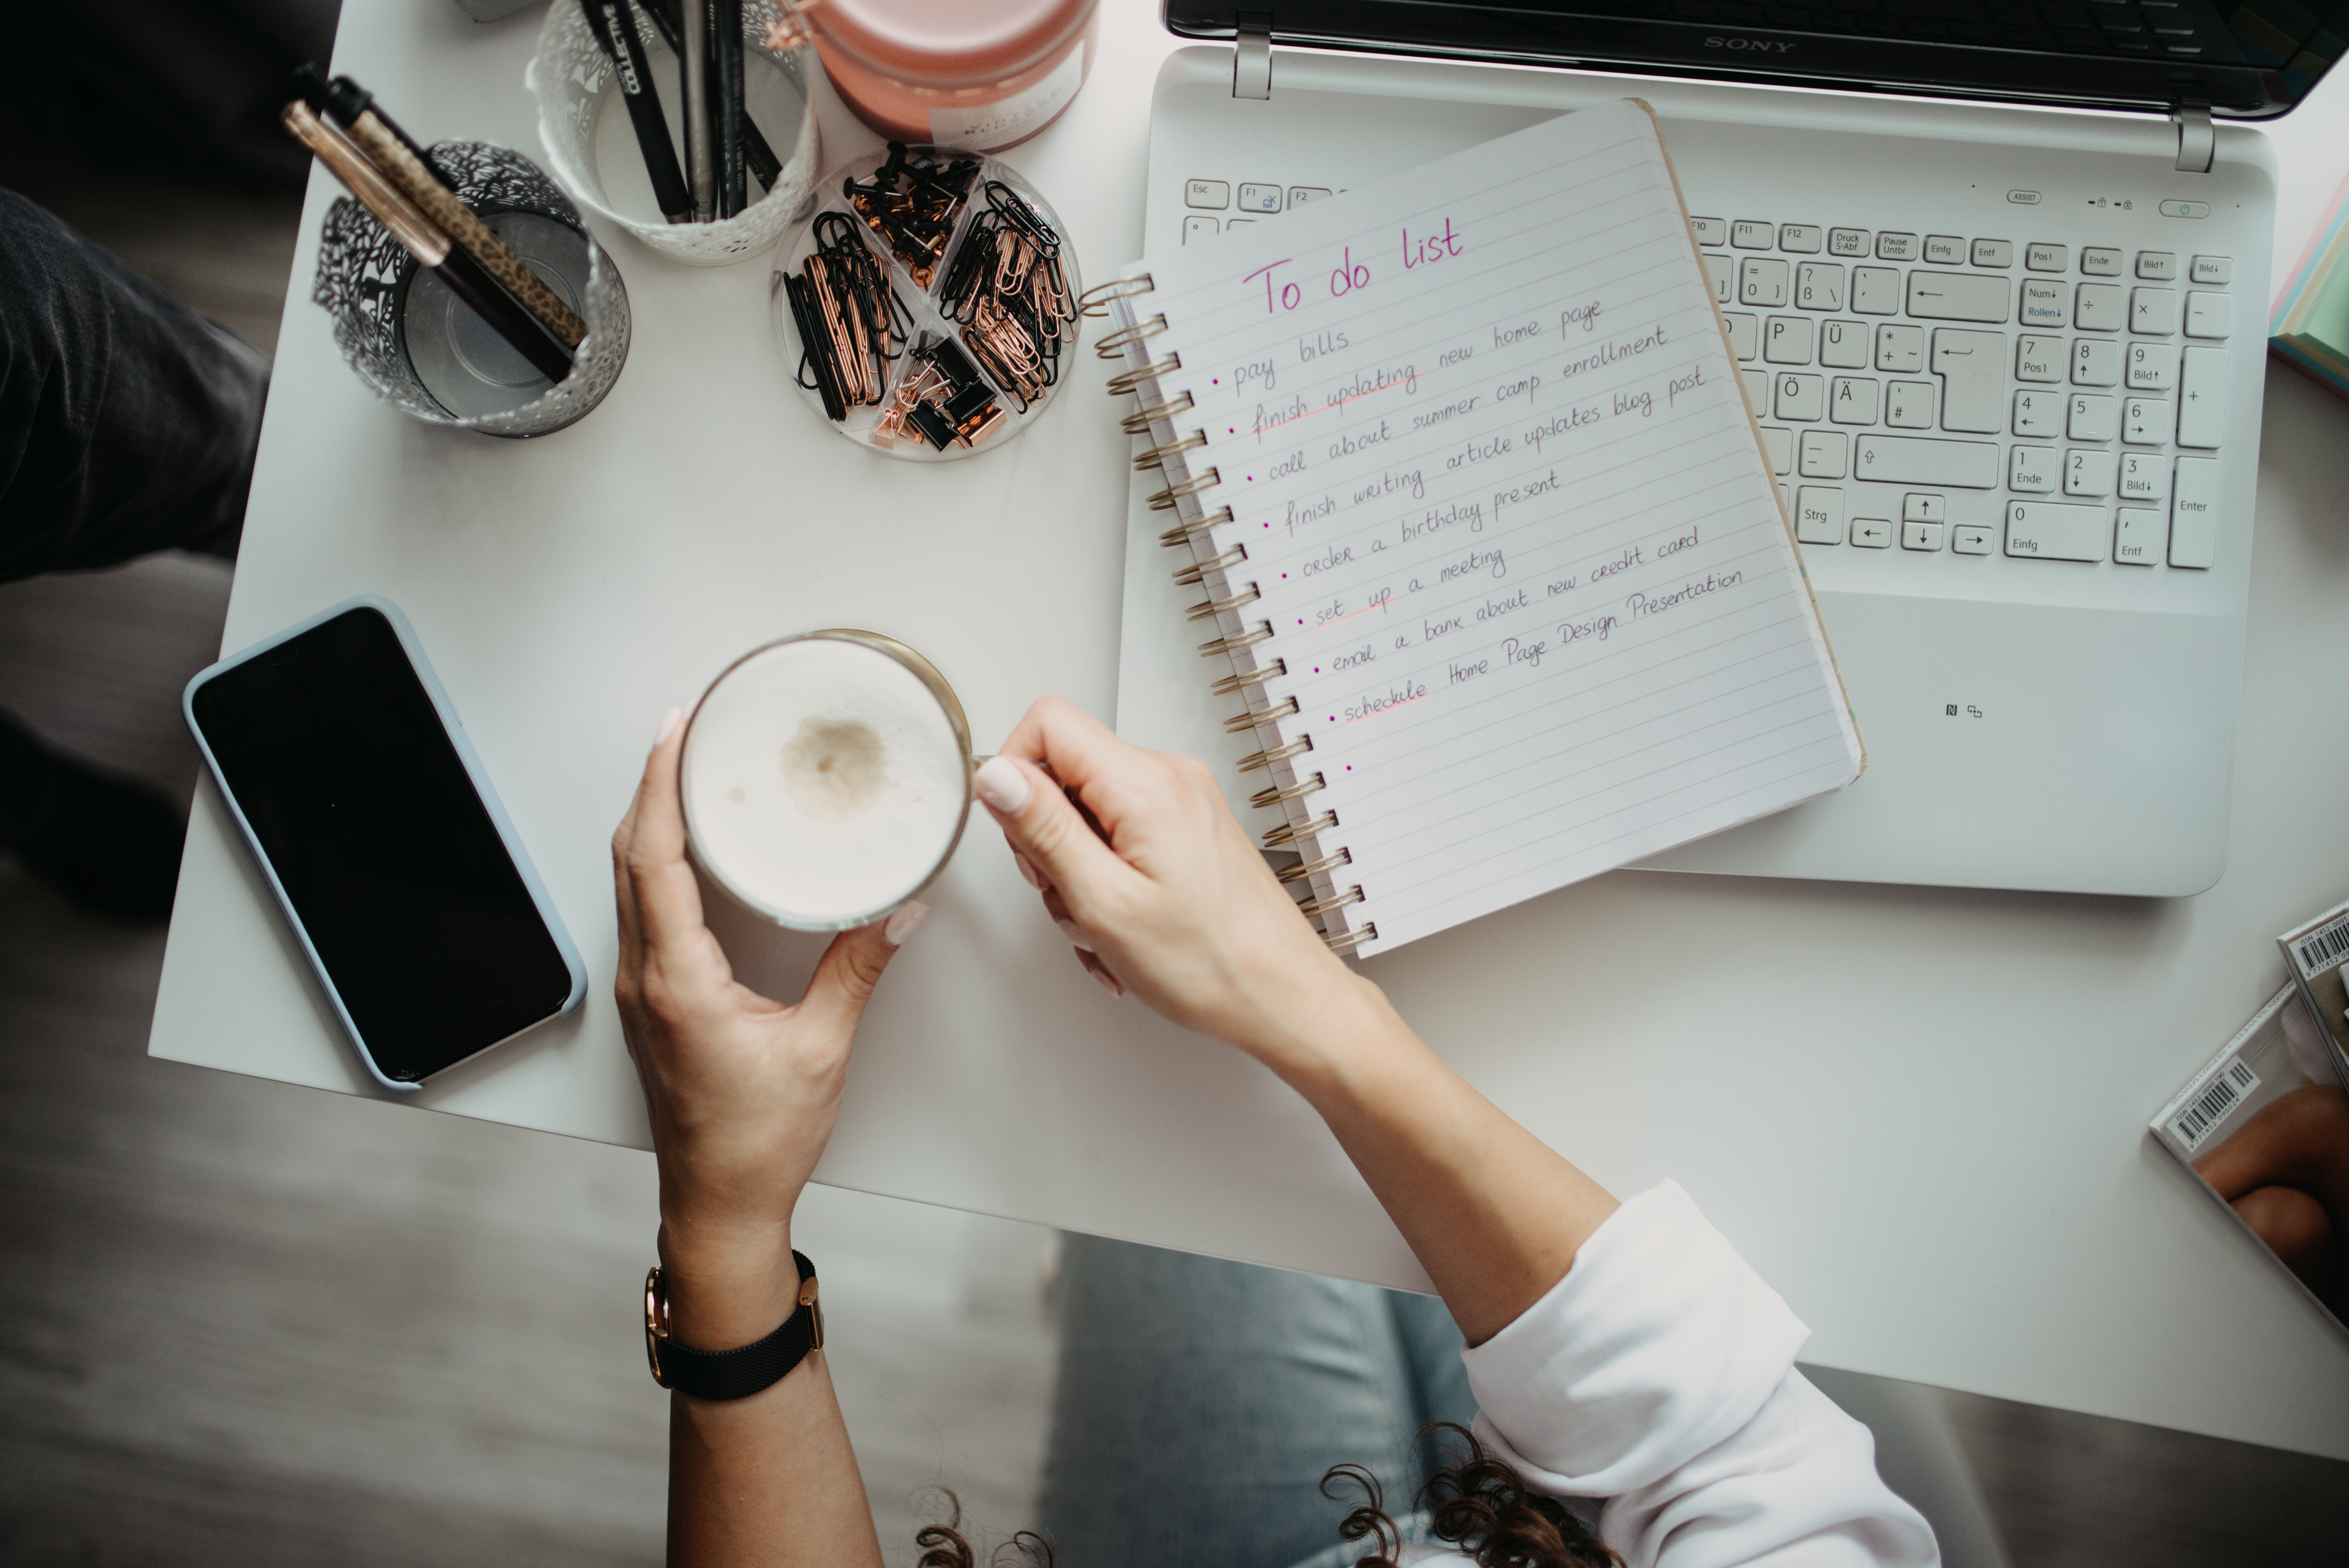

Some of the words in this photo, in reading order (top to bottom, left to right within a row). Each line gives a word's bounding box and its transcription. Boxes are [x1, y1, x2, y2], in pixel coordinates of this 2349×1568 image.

[602, 3, 642, 95] COLLECTIVE
[1703, 36, 1797, 53] SONY
[1193, 184, 1208, 193] Esc
[1246, 188, 1256, 197] F1
[1296, 192, 1307, 201] F2
[1691, 221, 1706, 230] F10
[1739, 225, 1752, 234] F11
[1788, 228, 1802, 238] F12
[1836, 233, 1859, 242] Druck
[1836, 242, 1857, 251] S-Abf
[1884, 238, 1907, 246] Pause
[1884, 246, 1905, 254] Untbr
[1931, 244, 1951, 256] Einfg
[1979, 248, 1995, 257] Entf
[2034, 252, 2052, 261] Pos1
[2089, 256, 2109, 265] Ende
[1243, 259, 1300, 313] To
[1331, 247, 1369, 296] do
[1805, 268, 1813, 282] ?
[1720, 280, 1725, 294] ]
[1775, 285, 1780, 299] }
[2029, 288, 2051, 298] Num
[2028, 307, 2055, 317] Rollen
[1774, 323, 1784, 339] P
[1829, 324, 1841, 344] Ü
[2026, 341, 2035, 354] 7
[2080, 345, 2089, 358] 8
[1884, 351, 1894, 361] +
[2136, 349, 2144, 362] 9
[1234, 358, 1275, 397] pay
[1300, 331, 1349, 362] bills
[2024, 362, 2046, 373] Pos1
[1252, 395, 1307, 444] finish
[1328, 364, 1417, 417] updating
[1439, 346, 1473, 367] new
[1494, 320, 1542, 348] home
[1562, 300, 1602, 341] page
[1784, 377, 1799, 397] Ö
[1840, 381, 1852, 401] Ä
[1269, 451, 1306, 481] call
[1329, 420, 1392, 459] about
[1413, 396, 1481, 430] summer
[1497, 375, 1541, 405] camp
[1563, 324, 1669, 378] enrollment
[2189, 391, 2198, 401] +
[2022, 397, 2031, 410] 4
[2077, 401, 2085, 414] 5
[1895, 406, 1902, 418] #
[2132, 404, 2141, 417] 6
[1285, 495, 1337, 538] finish
[1447, 435, 1512, 469] article
[1524, 406, 1601, 454] updates
[1613, 389, 1653, 418] blog
[1668, 364, 1706, 408] post
[2020, 452, 2024, 465] 1
[2074, 456, 2082, 469] 2
[2128, 460, 2137, 473] 3
[2017, 473, 2042, 484] Ende
[1372, 538, 1387, 552] a
[1402, 502, 1483, 542] birthday
[1494, 469, 1561, 522] present
[2180, 500, 2207, 511] Enter
[1805, 509, 1827, 524] Strg
[2013, 538, 2037, 552] Einfg
[2122, 545, 2142, 556] Entf
[1316, 599, 1345, 624] set
[1369, 586, 1391, 614] up
[1409, 577, 1424, 592] a
[1440, 549, 1506, 582] meeting
[1333, 645, 1377, 671] email
[1395, 634, 1410, 650] a
[1424, 615, 1465, 641] bank
[1476, 590, 1529, 622] about
[1547, 576, 1576, 596] new
[1344, 681, 1428, 721] schedule
[1449, 659, 1488, 685] Home
[1502, 637, 1548, 668] Page
[1557, 615, 1618, 644] Design
[1627, 570, 1743, 618] Presentation
[2300, 935, 2313, 946] ISSN
[2315, 916, 2348, 937] 1452-0095
[2313, 957, 2338, 974] 771452
[2176, 1109, 2188, 1122] ISSN
[2189, 1082, 2215, 1108] 1452-0095
[2195, 1121, 2217, 1144] 771452
[2217, 1096, 2240, 1121] 090024
